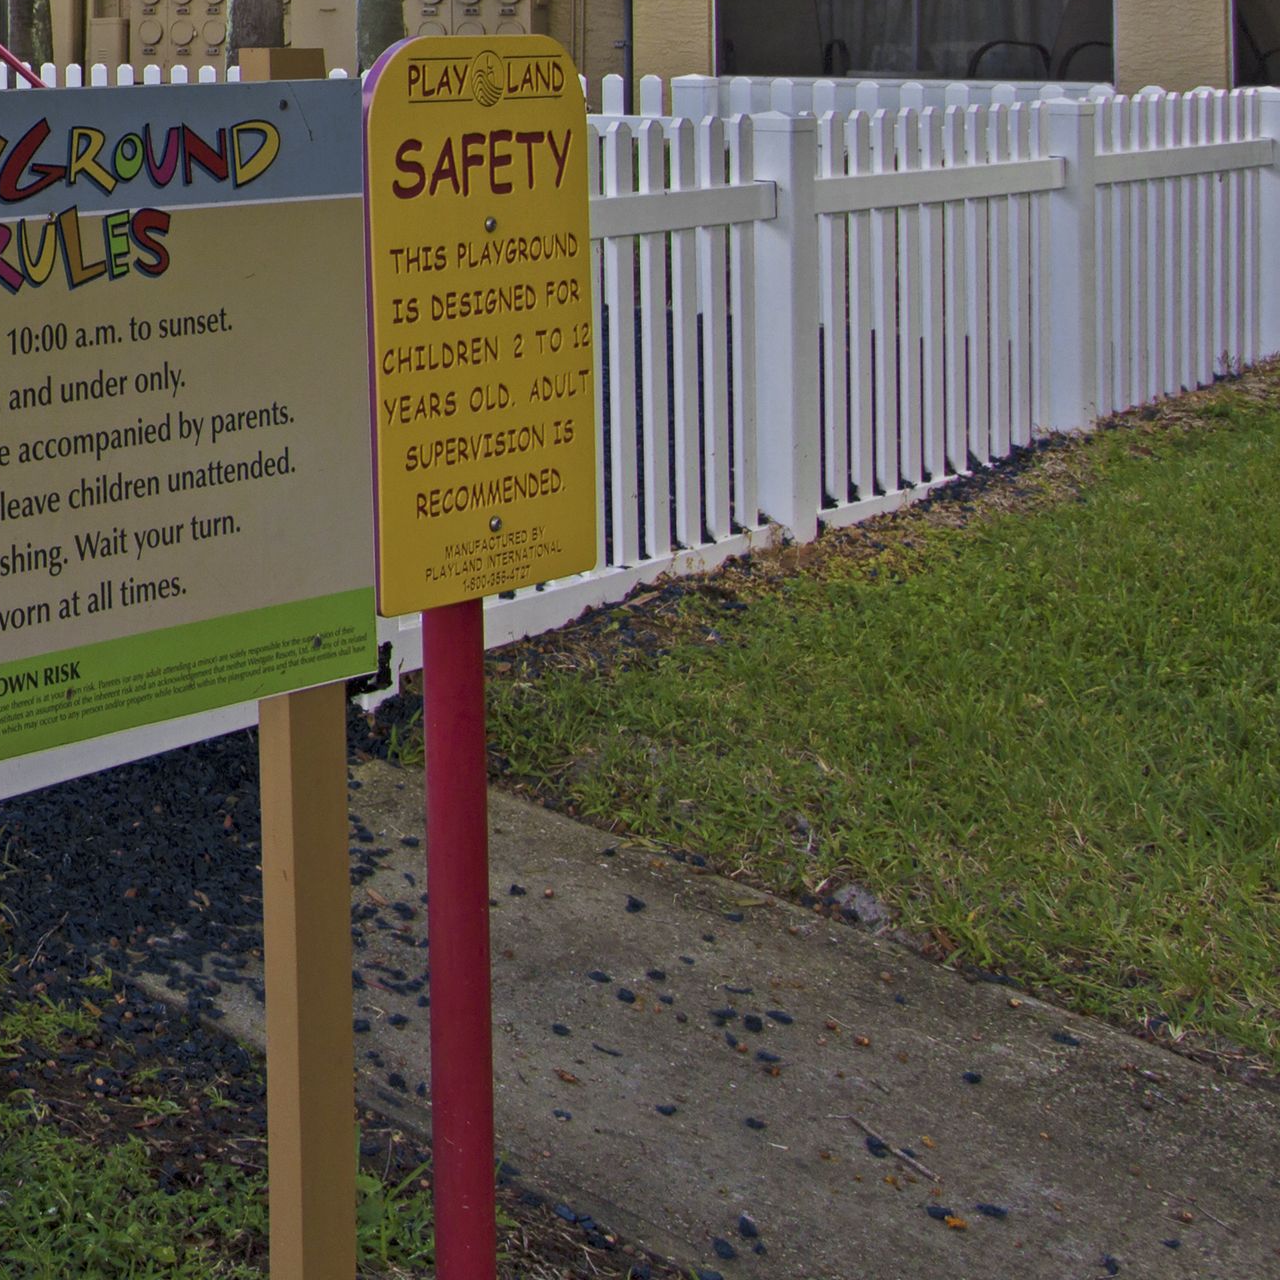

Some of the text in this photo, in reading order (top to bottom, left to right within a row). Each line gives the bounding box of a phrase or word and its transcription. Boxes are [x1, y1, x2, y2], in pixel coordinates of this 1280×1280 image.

[408, 61, 565, 96] PLAY LAND
[393, 129, 571, 199] SAFETY
[390, 232, 578, 273] THIS PLAYGROUND
[392, 279, 579, 324] IS DESIGNED FOR
[7, 323, 67, 355] 10:00
[76, 325, 122, 348] a.m.
[129, 317, 151, 341] to
[159, 308, 232, 338] sunset.
[383, 322, 590, 375] CHILDREN 2 TO 12
[9, 376, 52, 410] and
[61, 369, 127, 403] under
[135, 361, 185, 398] only.
[384, 370, 589, 425] YEARS OLD. ADULT
[19, 413, 170, 463] accompanied
[179, 411, 203, 446] by
[212, 402, 294, 443] parents.
[405, 420, 574, 471] SUPERVISION IS
[1, 491, 60, 521] leave
[69, 472, 159, 509] children
[168, 447, 295, 492] unattended.
[416, 468, 566, 519] RECOMMENDED.
[74, 527, 128, 561] Wait
[134, 524, 184, 560] your
[191, 516, 240, 540] turn.
[426, 540, 562, 582] PLAYLAND INTERNATIONAL
[445, 527, 545, 560] MANUFACTURED BY
[59, 591, 80, 619] at
[88, 580, 112, 613] all
[120, 577, 186, 606] times.
[44, 661, 80, 686] RISK
